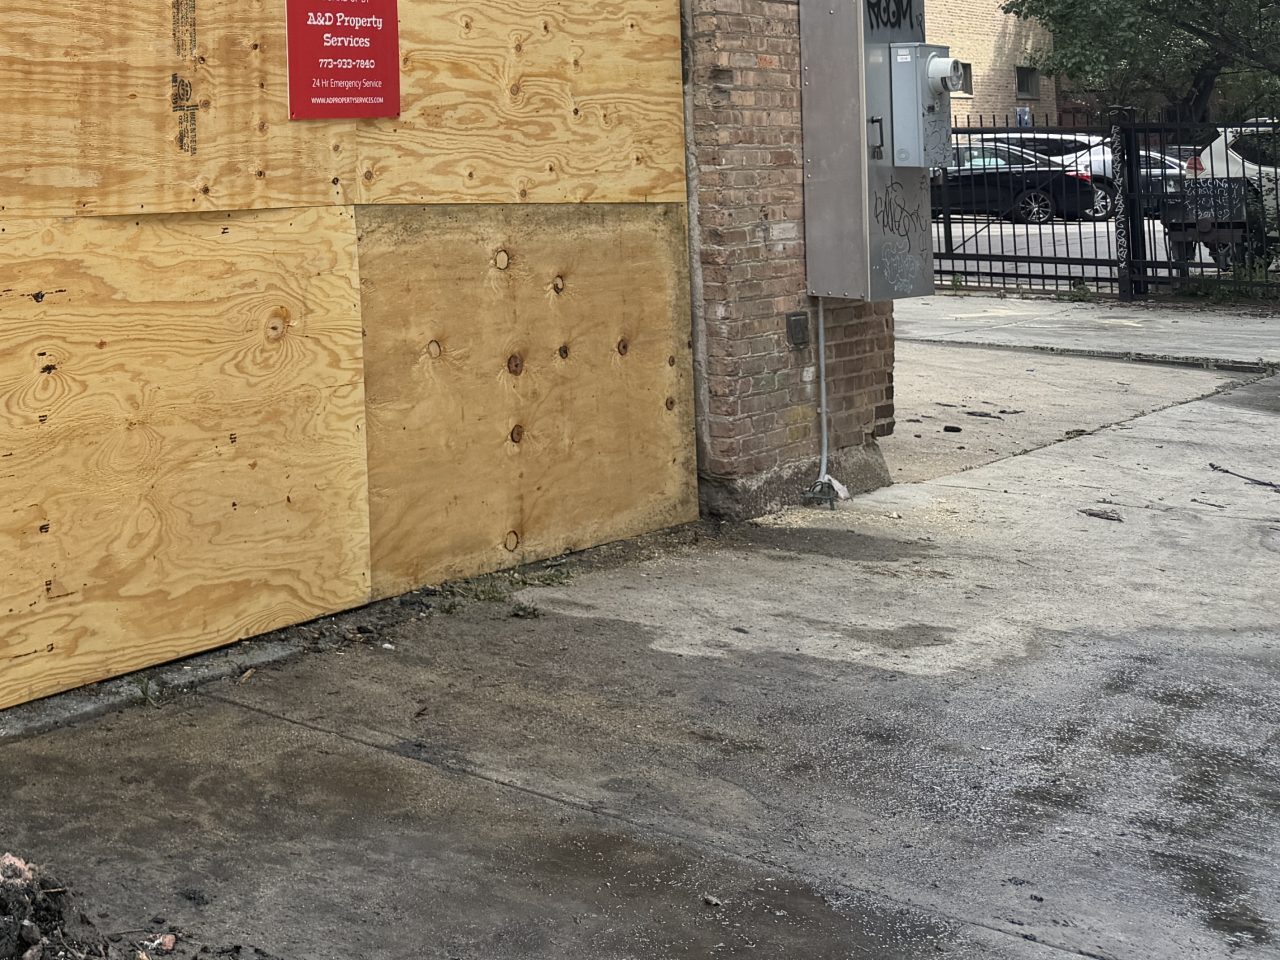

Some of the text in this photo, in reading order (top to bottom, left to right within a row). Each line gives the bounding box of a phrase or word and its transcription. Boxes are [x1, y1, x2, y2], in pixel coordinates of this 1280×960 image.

[306, 12, 383, 30] A&D Property
[323, 33, 370, 47] Services
[312, 78, 382, 90] 24 Hr Emergency Service
